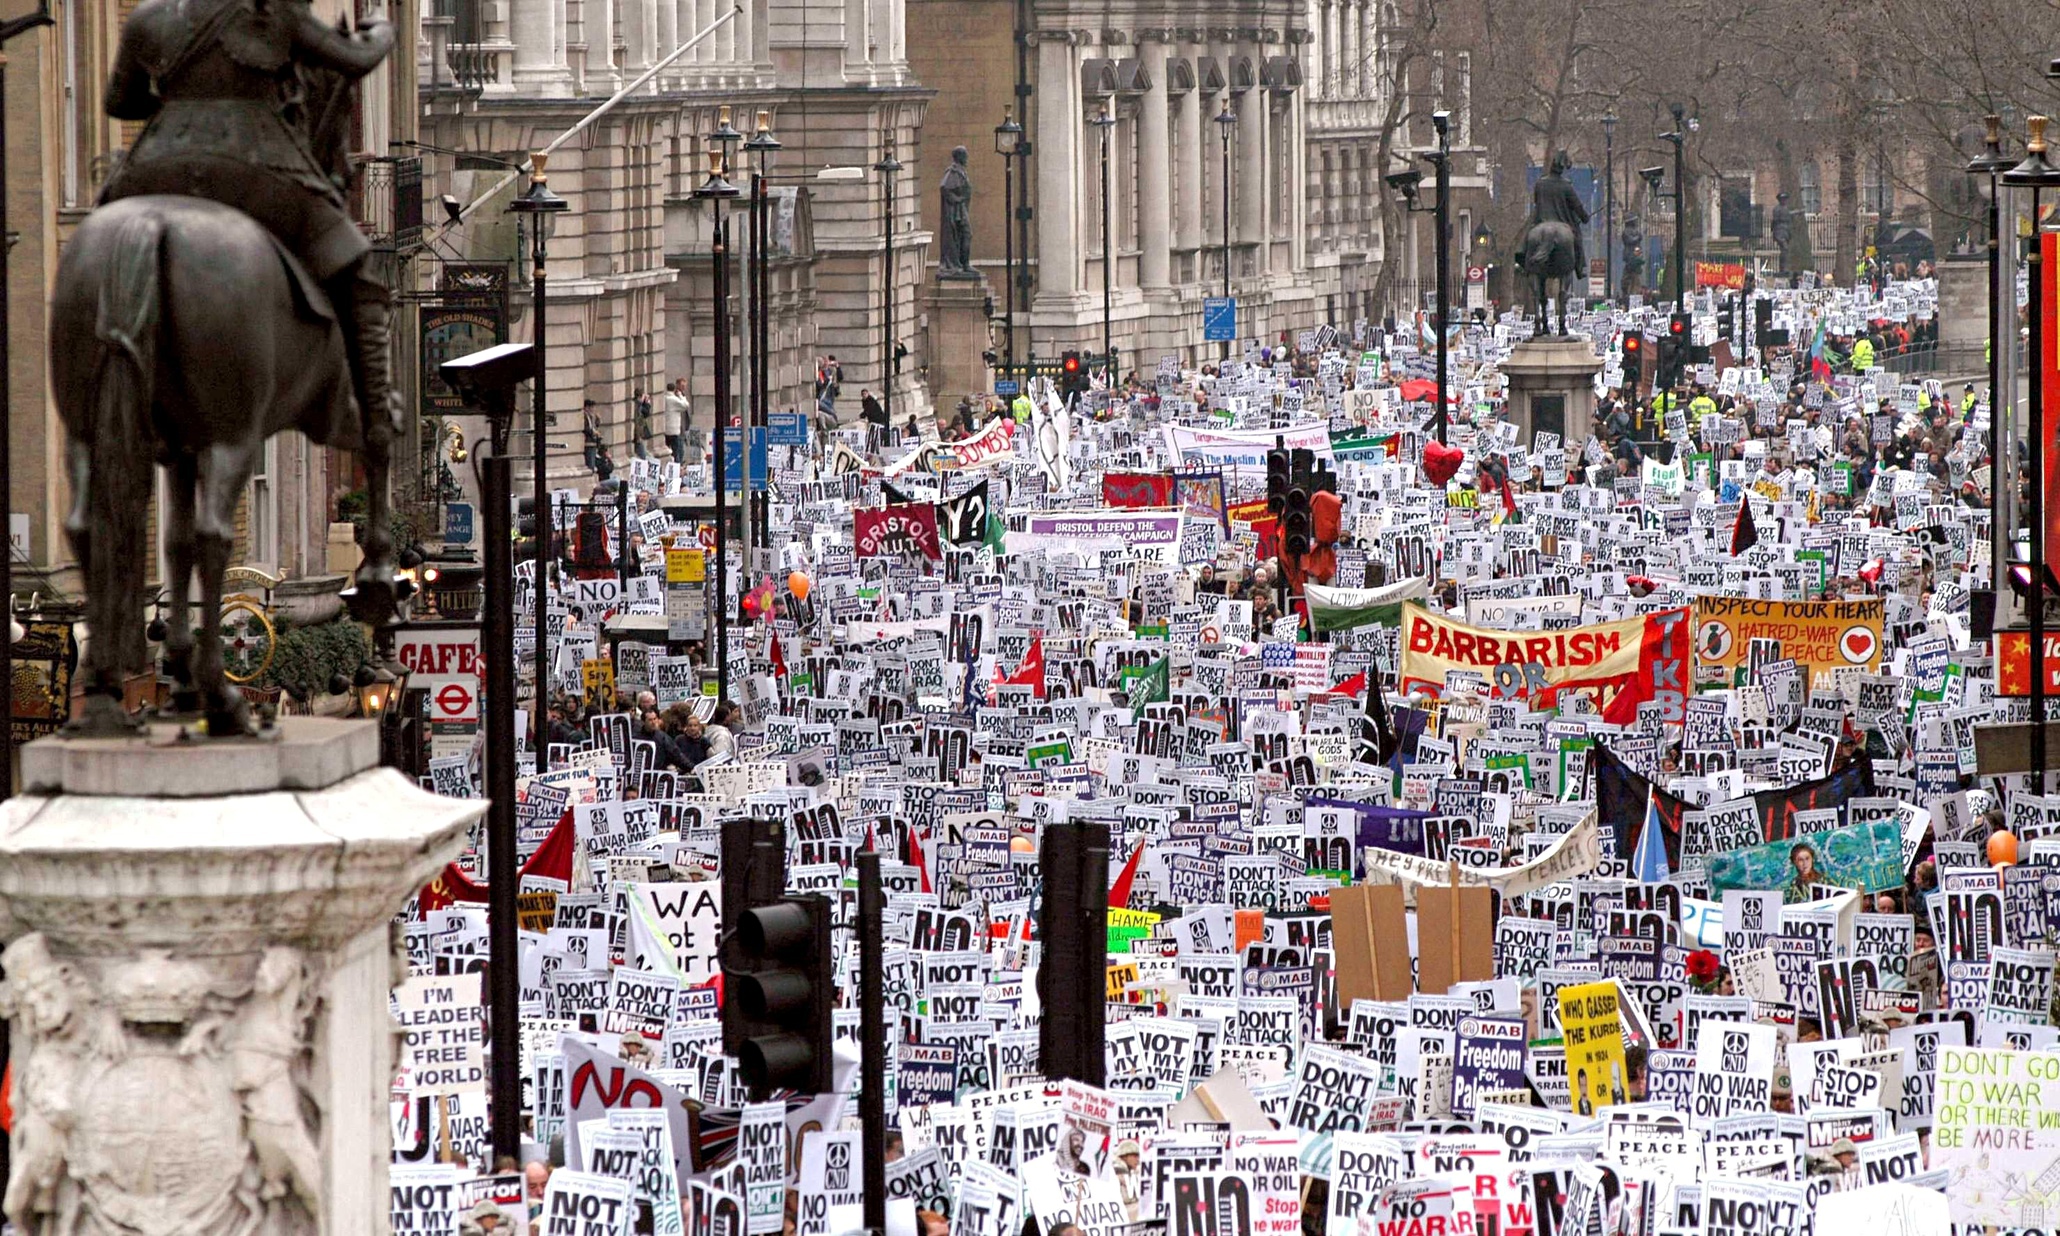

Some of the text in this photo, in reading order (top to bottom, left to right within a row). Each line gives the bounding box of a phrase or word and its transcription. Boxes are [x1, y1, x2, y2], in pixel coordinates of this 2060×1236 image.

[428, 314, 495, 329] THE OLD SHADES
[952, 426, 1010, 466] BOMBS
[1206, 454, 1256, 465] The Muslim
[1353, 452, 1374, 461] CND
[1825, 513, 1850, 522] STOP
[860, 516, 931, 552] BRISTOL
[1055, 522, 1155, 532] BRISTOL DEFEND THE
[1123, 531, 1173, 542] CAMPAIGN
[1843, 537, 1868, 550] FREE
[579, 582, 616, 600] NO
[1781, 601, 1830, 618] YOUR
[1834, 602, 1883, 619] HEART
[1409, 618, 1621, 667] BARBARISM
[1786, 644, 1834, 661] PEACE
[1917, 654, 1948, 668] Freedom
[1494, 664, 1550, 695] OR
[1804, 719, 1839, 729] DON'T
[841, 730, 873, 742] NOT
[434, 766, 465, 781] DON'T
[908, 766, 935, 778] DON'T
[1781, 759, 1822, 775] STOP
[1918, 768, 1956, 783] Freedom
[541, 788, 564, 800] MAB
[1135, 793, 1174, 805] DON'T
[861, 799, 892, 810] DON'T
[904, 802, 931, 813] THE
[1711, 809, 1752, 827] DON'T
[980, 831, 1007, 842] MAB
[1715, 820, 1756, 836] ATTACK
[677, 852, 717, 869] Mirror
[966, 847, 1008, 864] Freedom
[1451, 850, 1498, 866] STOP
[1940, 853, 1976, 866] DON'T
[985, 875, 1014, 885] MAB
[1230, 866, 1274, 880] DON'T
[1964, 876, 1995, 887] MAB
[1230, 880, 1275, 891] ATTACK
[1501, 932, 1552, 946] DON'T
[1783, 922, 1834, 939] NOT
[1856, 927, 1912, 944] DON'T
[1135, 941, 1176, 954] Mirror
[1502, 944, 1550, 958] ATTACK
[1855, 942, 1908, 957] ATTACK
[929, 964, 977, 982] NOT
[1601, 955, 1654, 979] Freedom
[424, 988, 453, 1003] I'M
[617, 982, 675, 1004] DON'T
[678, 992, 715, 1008] MAB
[616, 999, 672, 1018] ATTACK
[933, 997, 980, 1014] NOT
[1564, 996, 1616, 1018] WHO GASSED
[1991, 994, 2048, 1011] NAME
[402, 1008, 481, 1025] LEADER
[606, 1011, 664, 1038] Mirror
[406, 1028, 481, 1046] OF THE
[1481, 1024, 1520, 1037] MAB
[1566, 1023, 1620, 1046] THE KURDS
[414, 1048, 467, 1064] FREE
[914, 1049, 953, 1062] MAB
[1326, 1054, 1337, 1063] the
[1339, 1057, 1349, 1066] War
[1459, 1039, 1521, 1070] Freedom
[1587, 1052, 1592, 1062] IN
[1945, 1051, 2060, 1080] DON'T GO
[1302, 1061, 1375, 1097] DON'T
[1479, 1068, 1498, 1082] For
[1826, 1068, 1877, 1097] STOP
[571, 1059, 663, 1111] NO
[1698, 1074, 1767, 1100] NO WAR
[1941, 1080, 2041, 1106] TO WAR
[912, 1091, 930, 1102] For
[1068, 1088, 1116, 1108] Stop The War
[1300, 1084, 1367, 1115] ATTACK
[1084, 1105, 1107, 1119] IRAQ
[1696, 1097, 1720, 1118] ON
[1941, 1106, 1968, 1125] OR
[1974, 1107, 2032, 1127] THERE
[743, 1122, 783, 1147] NOT
[1808, 1119, 1872, 1147] Mirror
[1938, 1128, 1962, 1147] BE
[1620, 1141, 1687, 1154] PEACE
[1716, 1145, 1784, 1157] PEACE
[593, 1149, 638, 1174] NOT
[1236, 1156, 1298, 1174] NO WAR
[1339, 1150, 1400, 1175] DON'T
[1866, 1152, 1918, 1184] NOT
[393, 1185, 454, 1210] NOT
[458, 1181, 521, 1210] Mirror
[552, 1191, 622, 1219] NOT
[803, 1195, 826, 1219] NO
[1265, 1197, 1299, 1216] Stop
[1392, 1200, 1427, 1219] NO
[422, 1210, 453, 1229] MY
[1271, 1219, 1300, 1232] war
